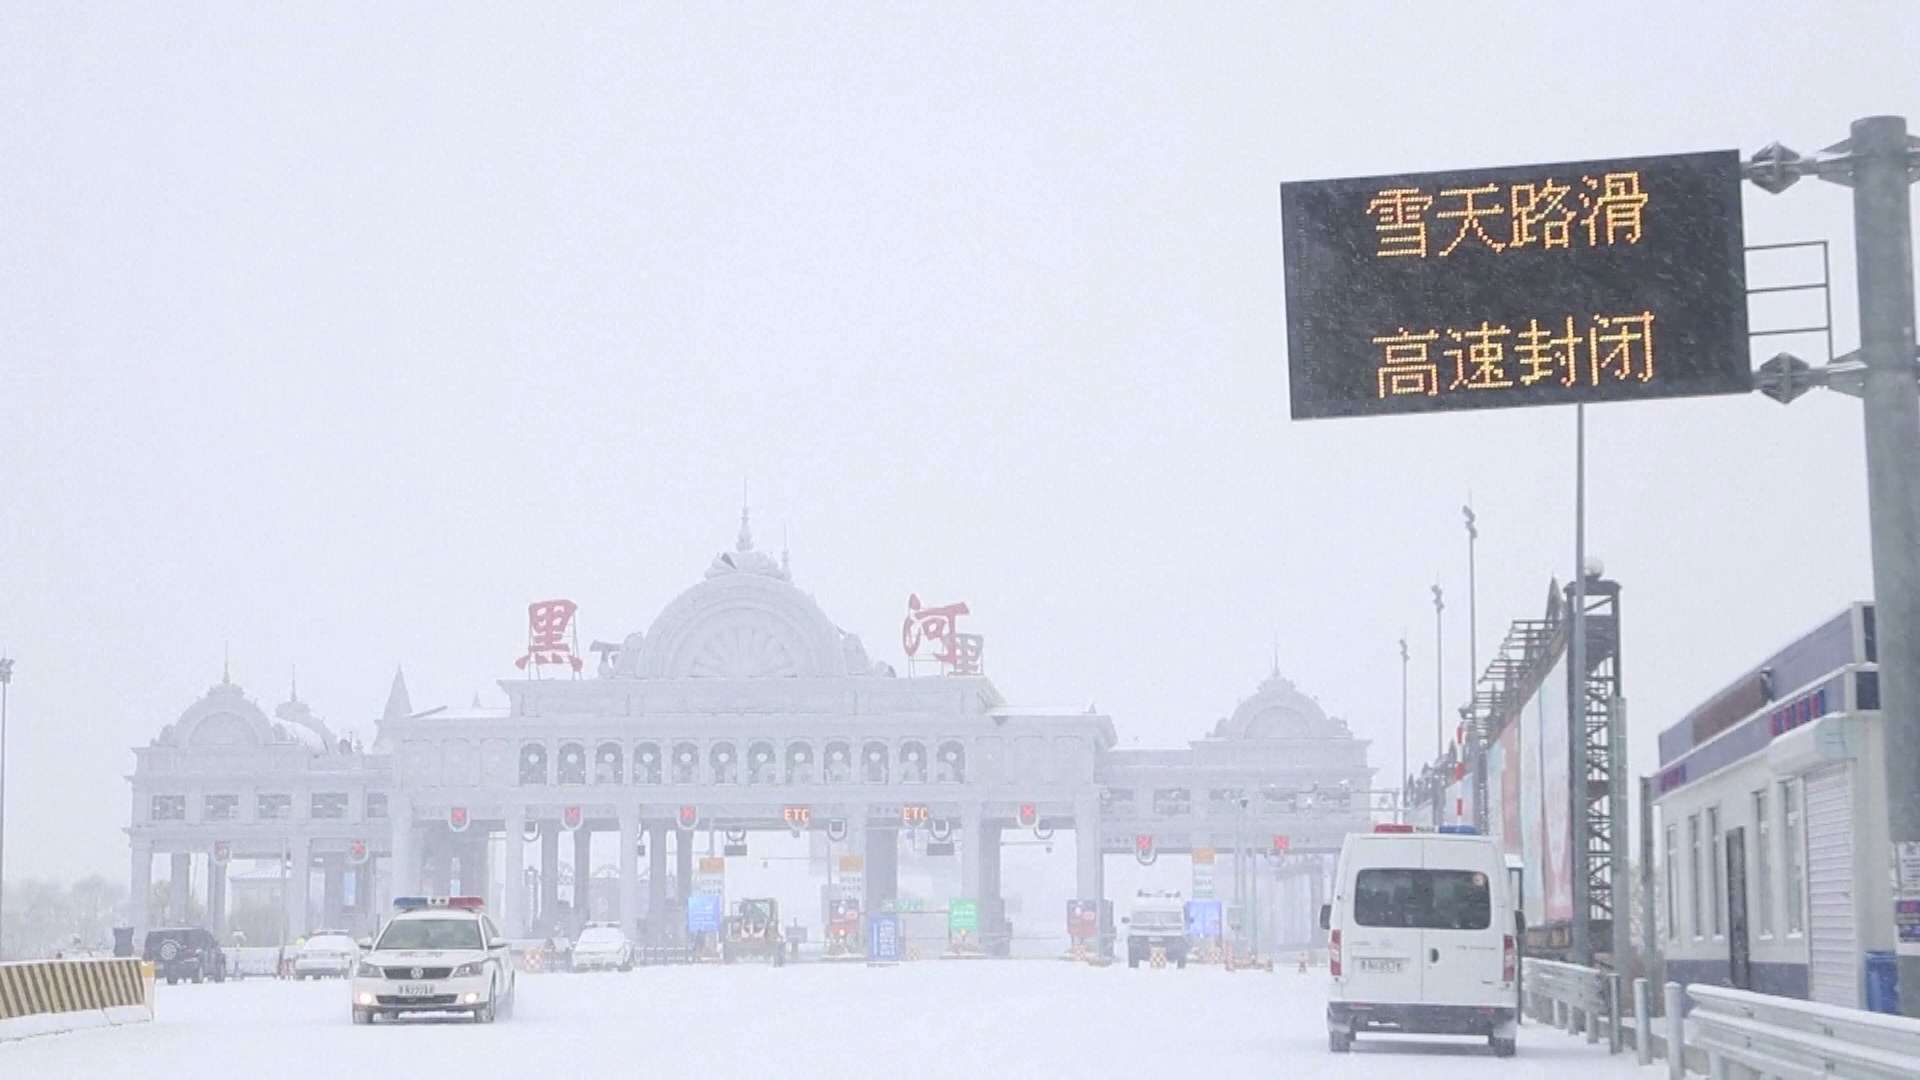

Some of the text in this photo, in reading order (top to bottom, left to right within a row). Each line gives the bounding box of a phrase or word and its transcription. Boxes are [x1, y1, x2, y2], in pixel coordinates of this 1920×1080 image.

[1366, 171, 1649, 258] 雪天路滑
[1372, 310, 1655, 399] 高速封闭
[515, 599, 583, 672] 黑
[903, 593, 970, 664] 河
[784, 808, 810, 822] ETC
[903, 806, 929, 821] ETC
